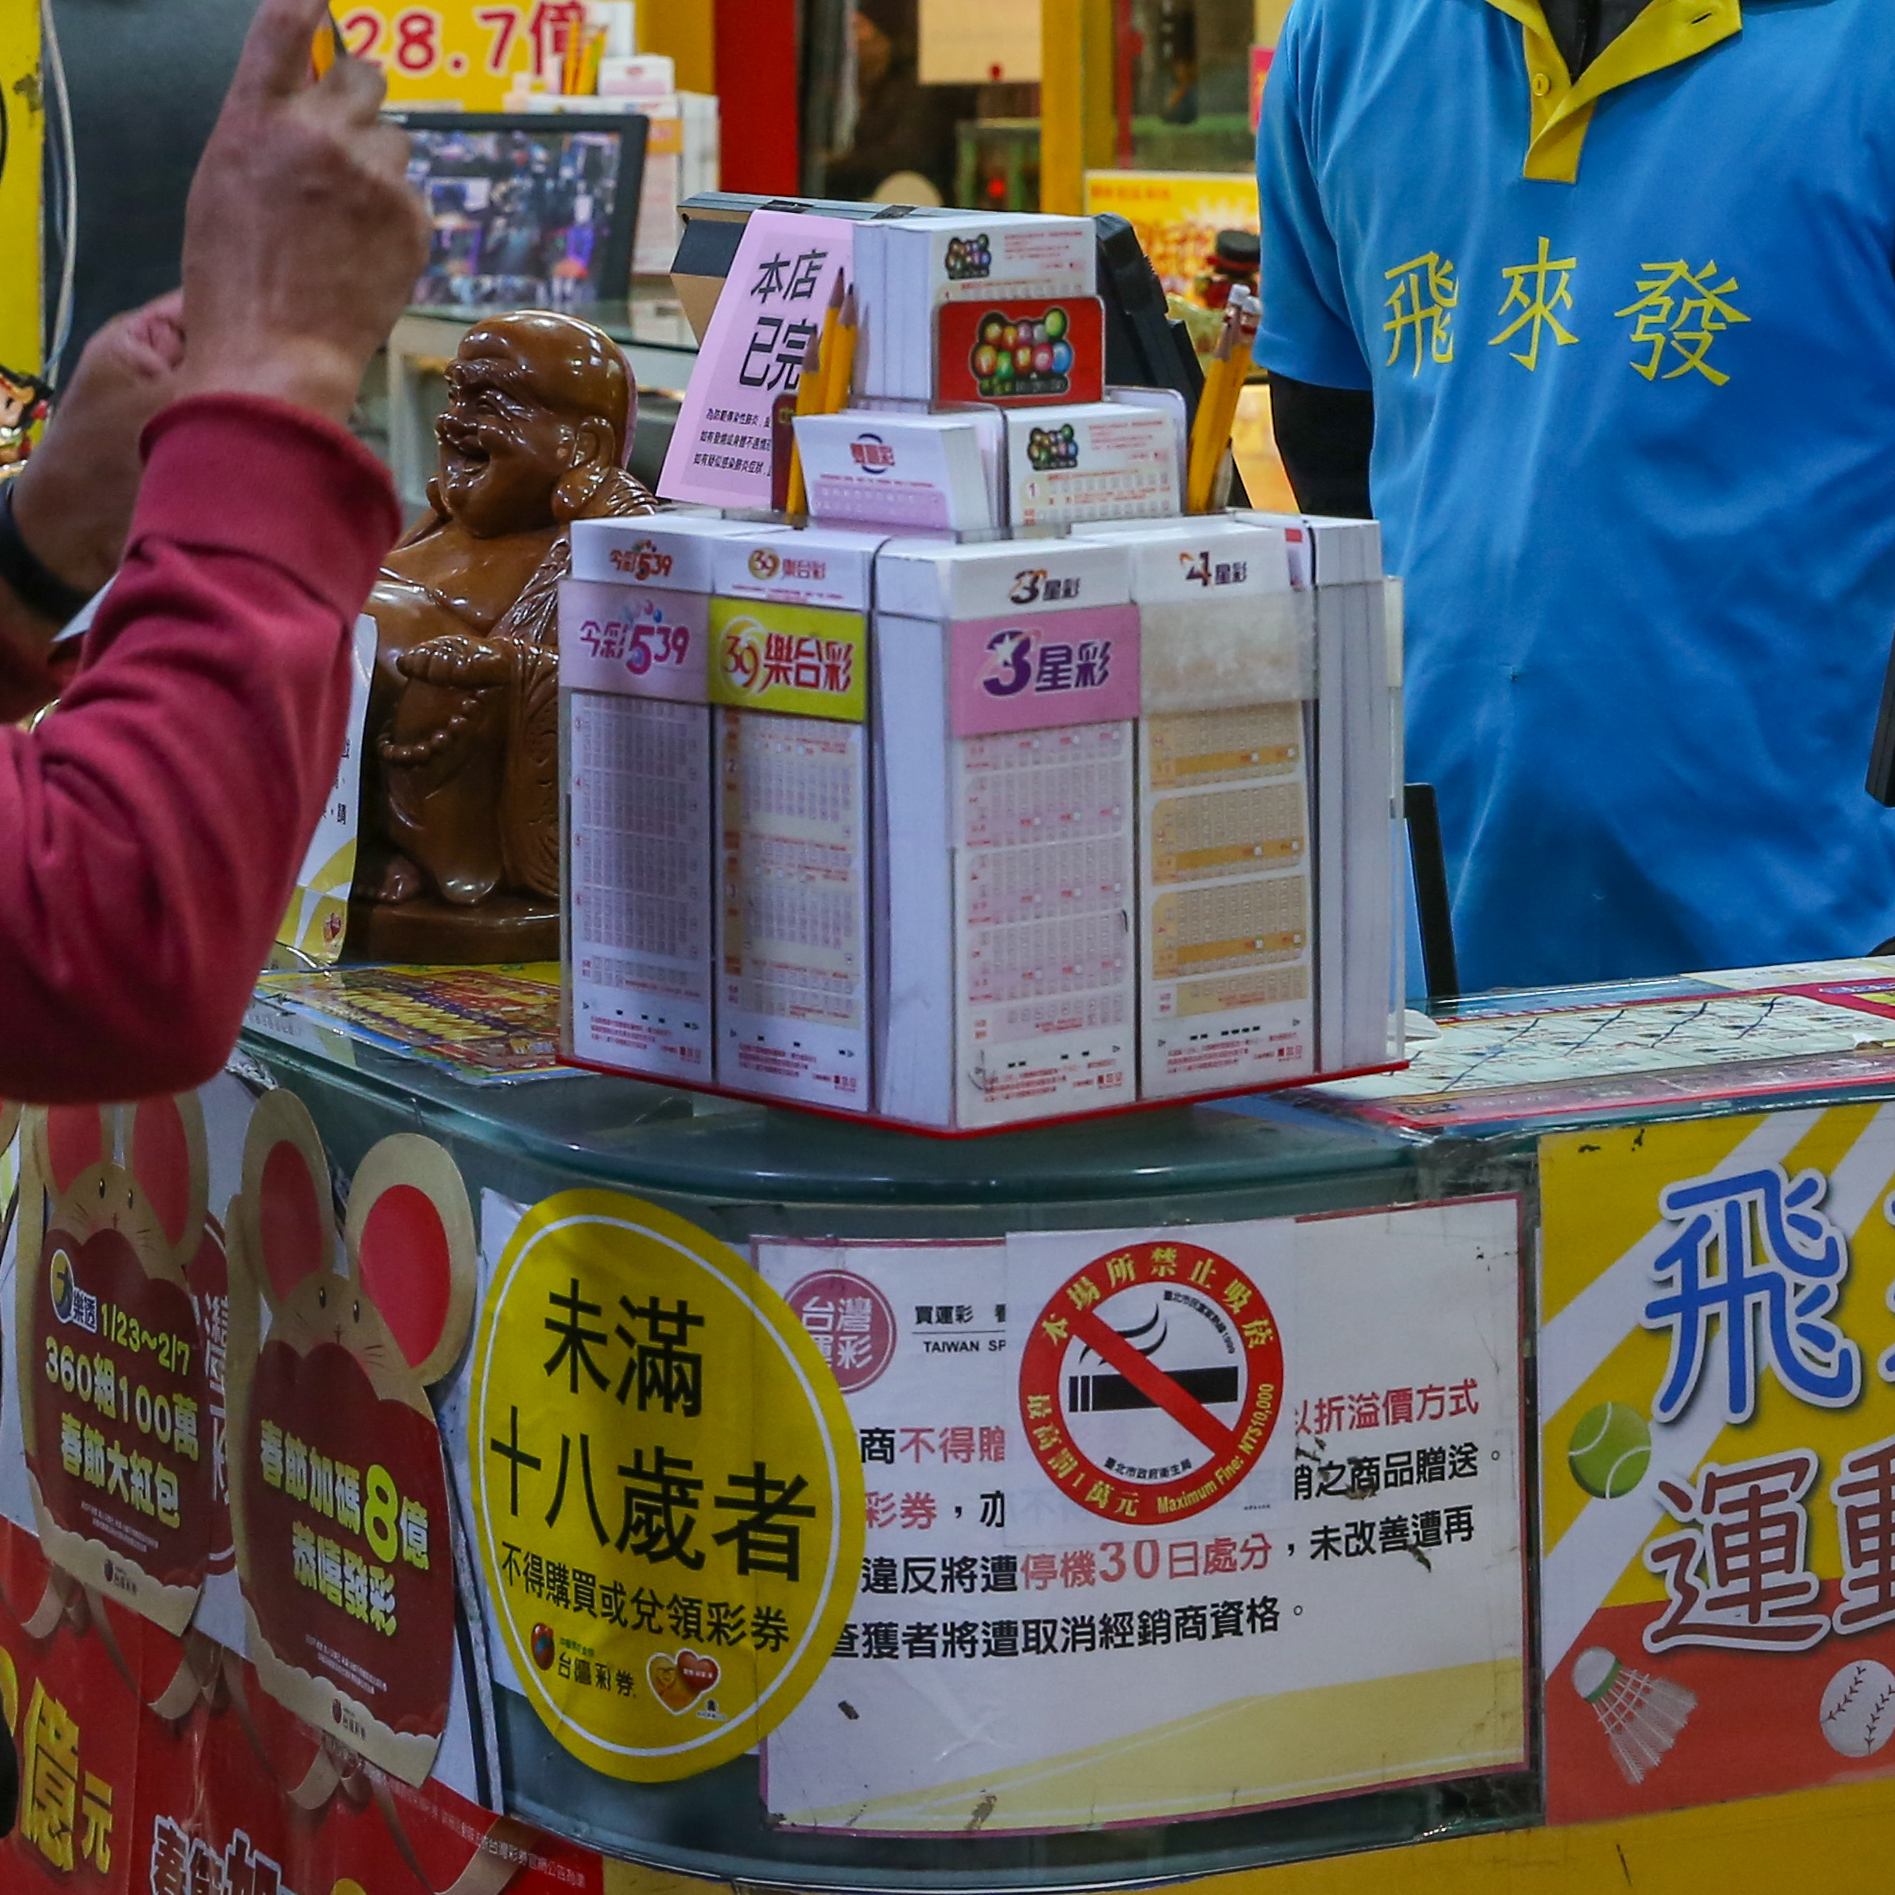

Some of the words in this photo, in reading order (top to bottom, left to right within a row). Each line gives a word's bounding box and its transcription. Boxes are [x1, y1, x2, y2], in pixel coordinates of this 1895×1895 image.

[750, 248, 829, 304] 本店
[1382, 236, 1752, 387] 飛來發
[580, 606, 690, 676] 今彩539
[982, 629, 1113, 697] 3星彩
[543, 1276, 705, 1419] 未滿
[800, 1295, 871, 1338] 台灣
[915, 1304, 975, 1327] 買運彩
[922, 1340, 982, 1355] TAIWAN
[44, 1335, 199, 1462] 360組100萬
[59, 1412, 180, 1530] 春節大紅包
[259, 1419, 431, 1571] 春節加碼8億
[488, 1405, 816, 1585] 十八歲者
[1157, 1481, 1217, 1514] Maximum
[1214, 1454, 1244, 1485] Fine:
[500, 1540, 791, 1656] 不得購買或兌領彩券
[861, 1505, 1476, 1599] 違反將遭停機30日處分，未改善遭再
[21, 1677, 113, 1875] 億元
